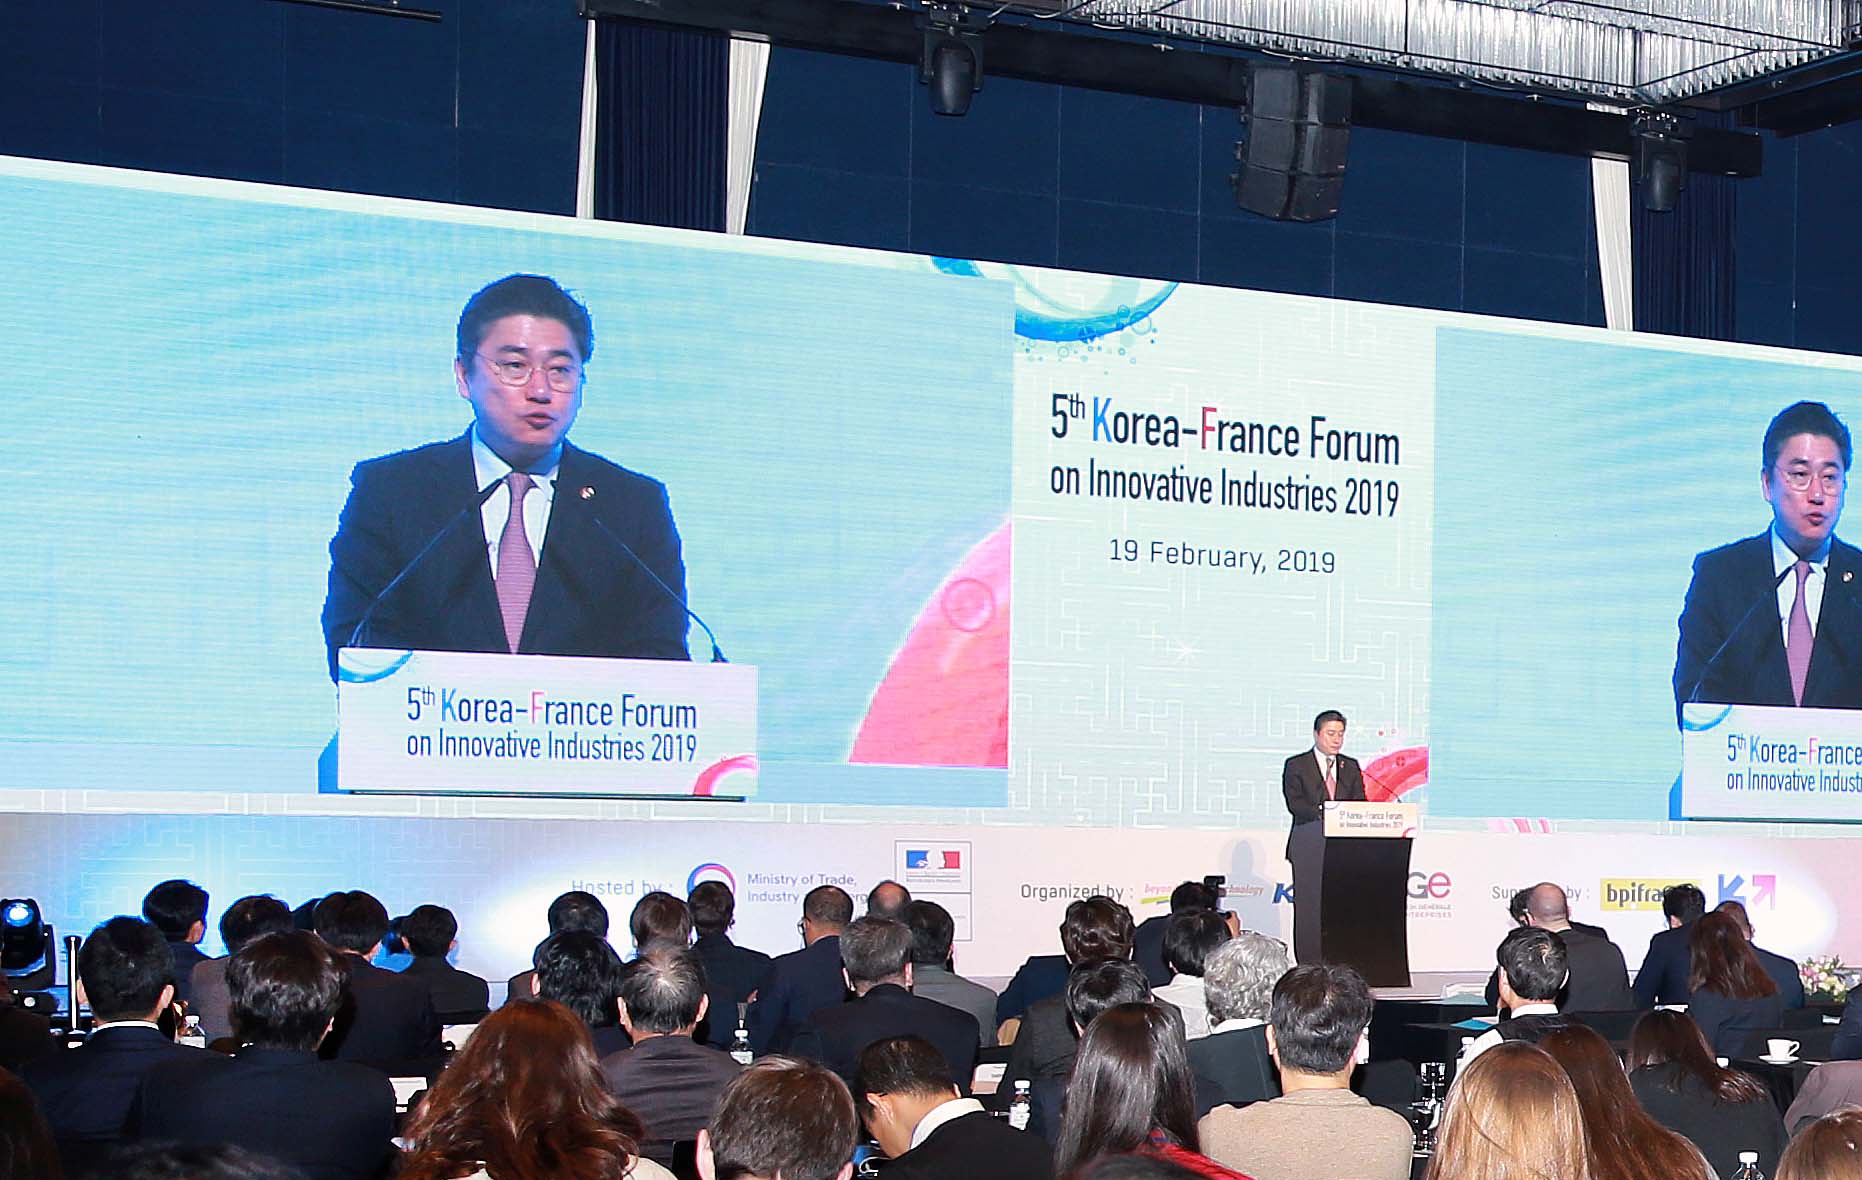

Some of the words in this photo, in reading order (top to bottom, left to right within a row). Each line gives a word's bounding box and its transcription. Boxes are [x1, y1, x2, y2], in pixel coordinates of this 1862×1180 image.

[1051, 392, 1086, 438] 5th
[1092, 396, 1300, 457] Korea-France
[1310, 415, 1400, 465] Forum
[1051, 463, 1080, 496] on
[1089, 457, 1213, 504] Innovative
[1221, 468, 1337, 514] Industries
[1345, 477, 1399, 518] 2019
[1110, 538, 1138, 562] 19
[1151, 540, 1267, 575] February,
[1278, 549, 1336, 574] 2019
[407, 686, 435, 721] 5th
[441, 688, 613, 727] Korea-France
[621, 692, 697, 729] Forum
[407, 732, 431, 757] on
[439, 728, 541, 760] Innovative
[548, 731, 645, 762] Industries
[651, 734, 697, 763] 2019
[1750, 735, 1862, 766] Korea-France
[1727, 771, 1743, 791] on
[1748, 768, 1815, 792] Innovative
[572, 880, 634, 895] Hosted
[747, 873, 798, 887] Ministry
[801, 874, 813, 885] of
[1021, 883, 1099, 902] Organized
[1407, 871, 1452, 899] Ge
[748, 891, 799, 904] Industry
[1607, 882, 1664, 907] bpifra
